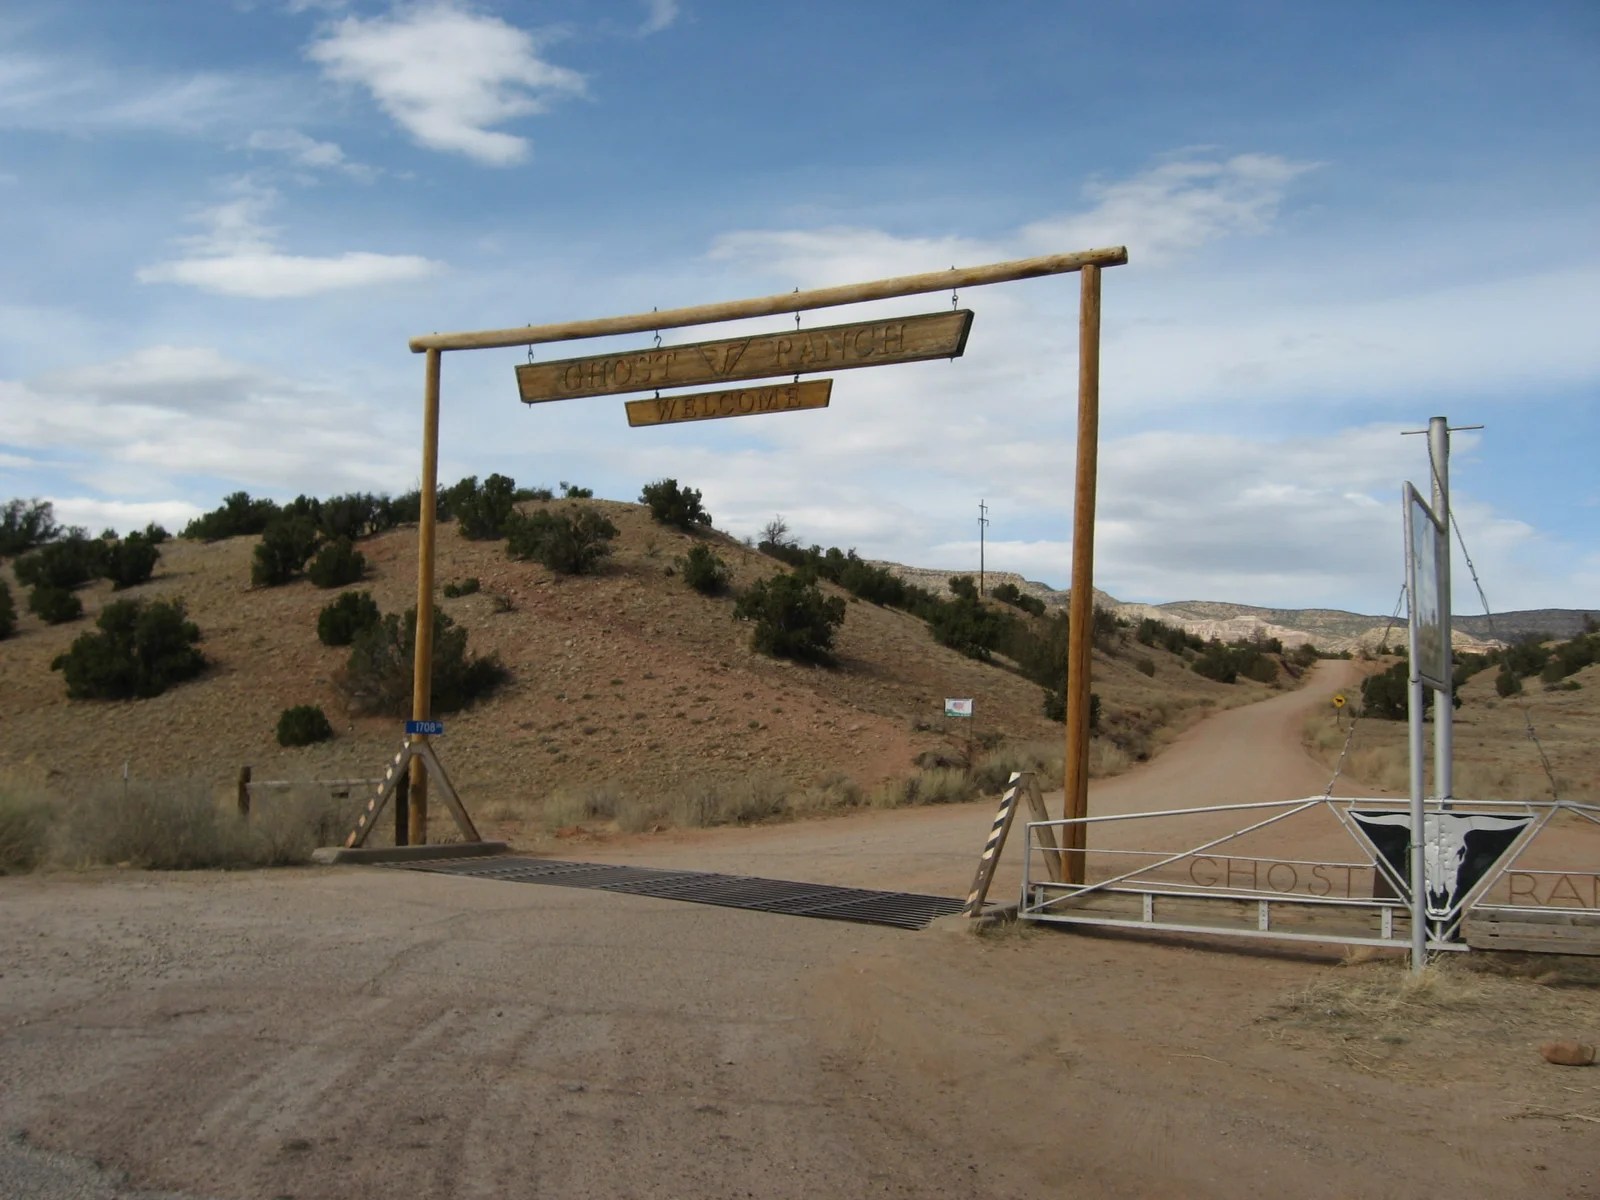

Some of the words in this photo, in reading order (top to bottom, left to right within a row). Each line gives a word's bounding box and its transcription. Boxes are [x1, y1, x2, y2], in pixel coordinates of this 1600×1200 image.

[565, 352, 677, 390] GHOST
[773, 324, 906, 368] RANCH
[656, 386, 801, 421] WELCOME
[1189, 857, 1368, 899] GHOST
